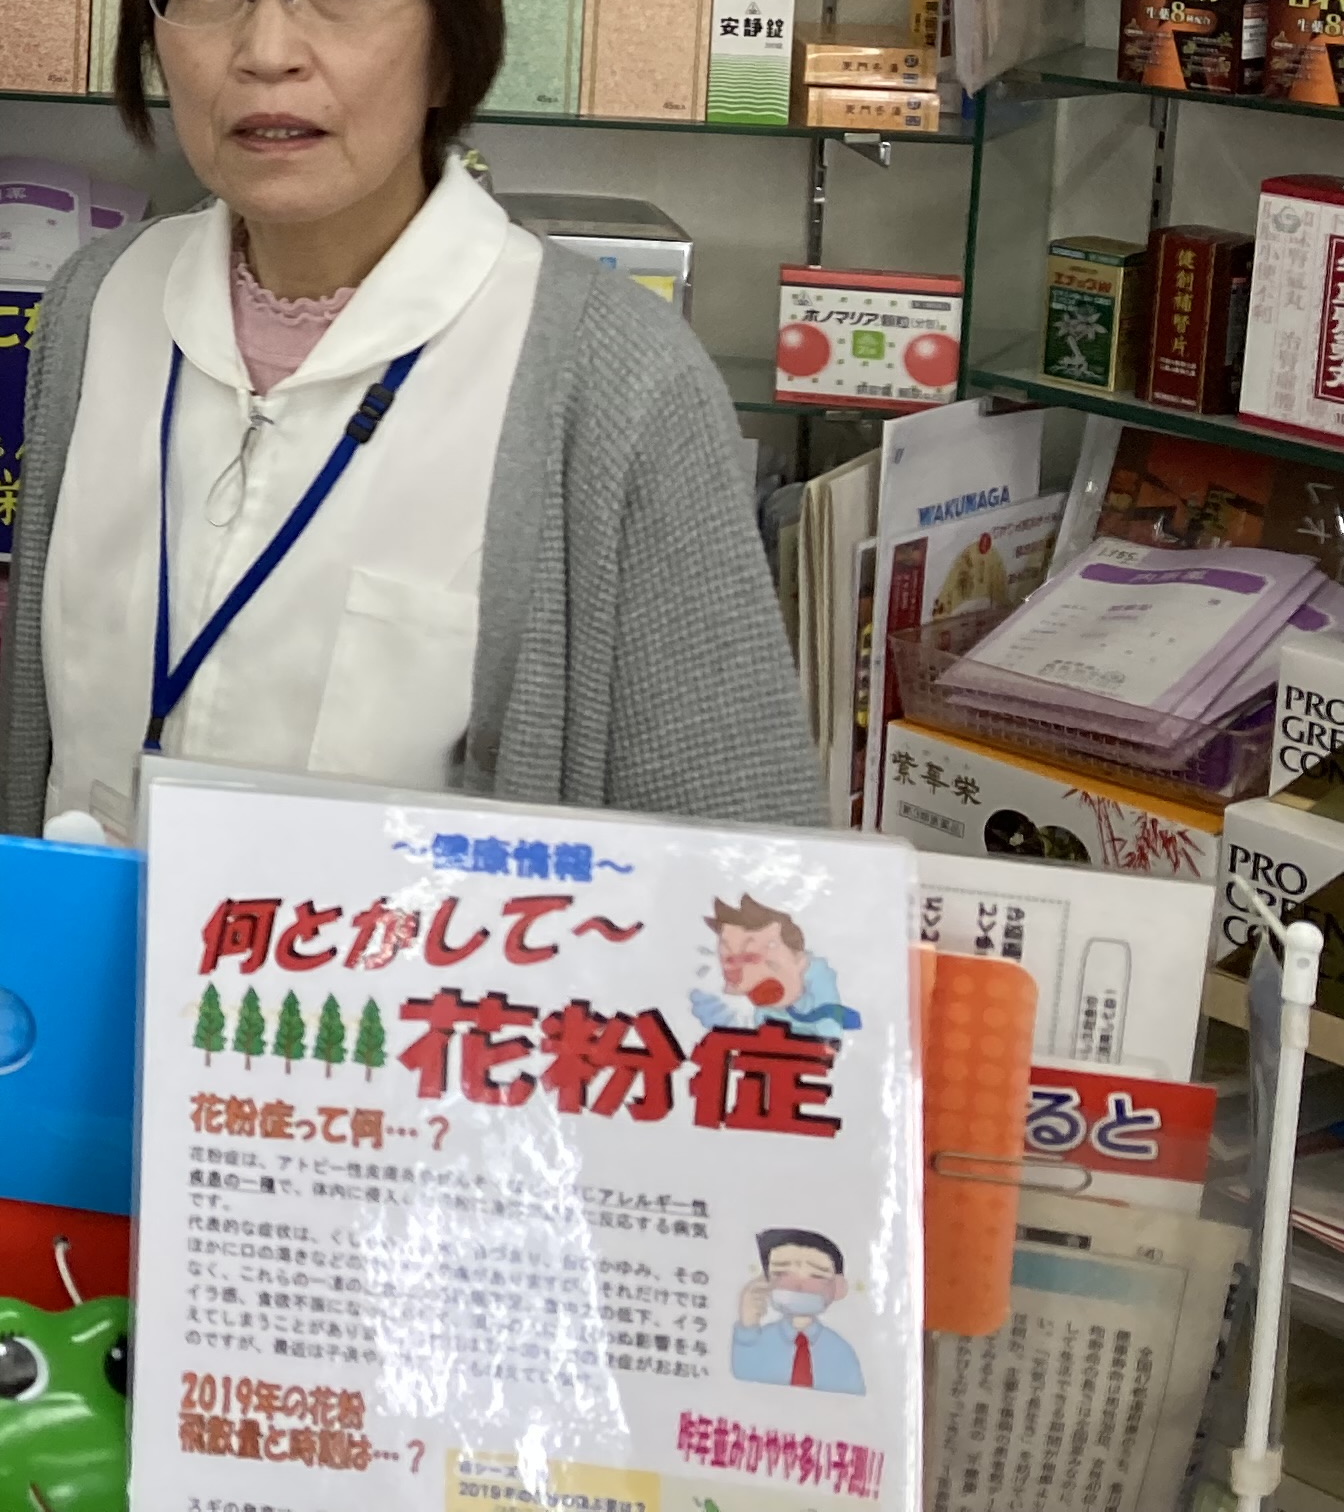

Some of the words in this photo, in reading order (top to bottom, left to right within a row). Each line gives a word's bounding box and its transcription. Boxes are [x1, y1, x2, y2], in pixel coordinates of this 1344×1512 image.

[918, 485, 1010, 526] WAKUNAGA
[1228, 842, 1308, 897] PRO
[397, 987, 842, 1138] 花粉症
[181, 1371, 366, 1430] 2019年の花粉
